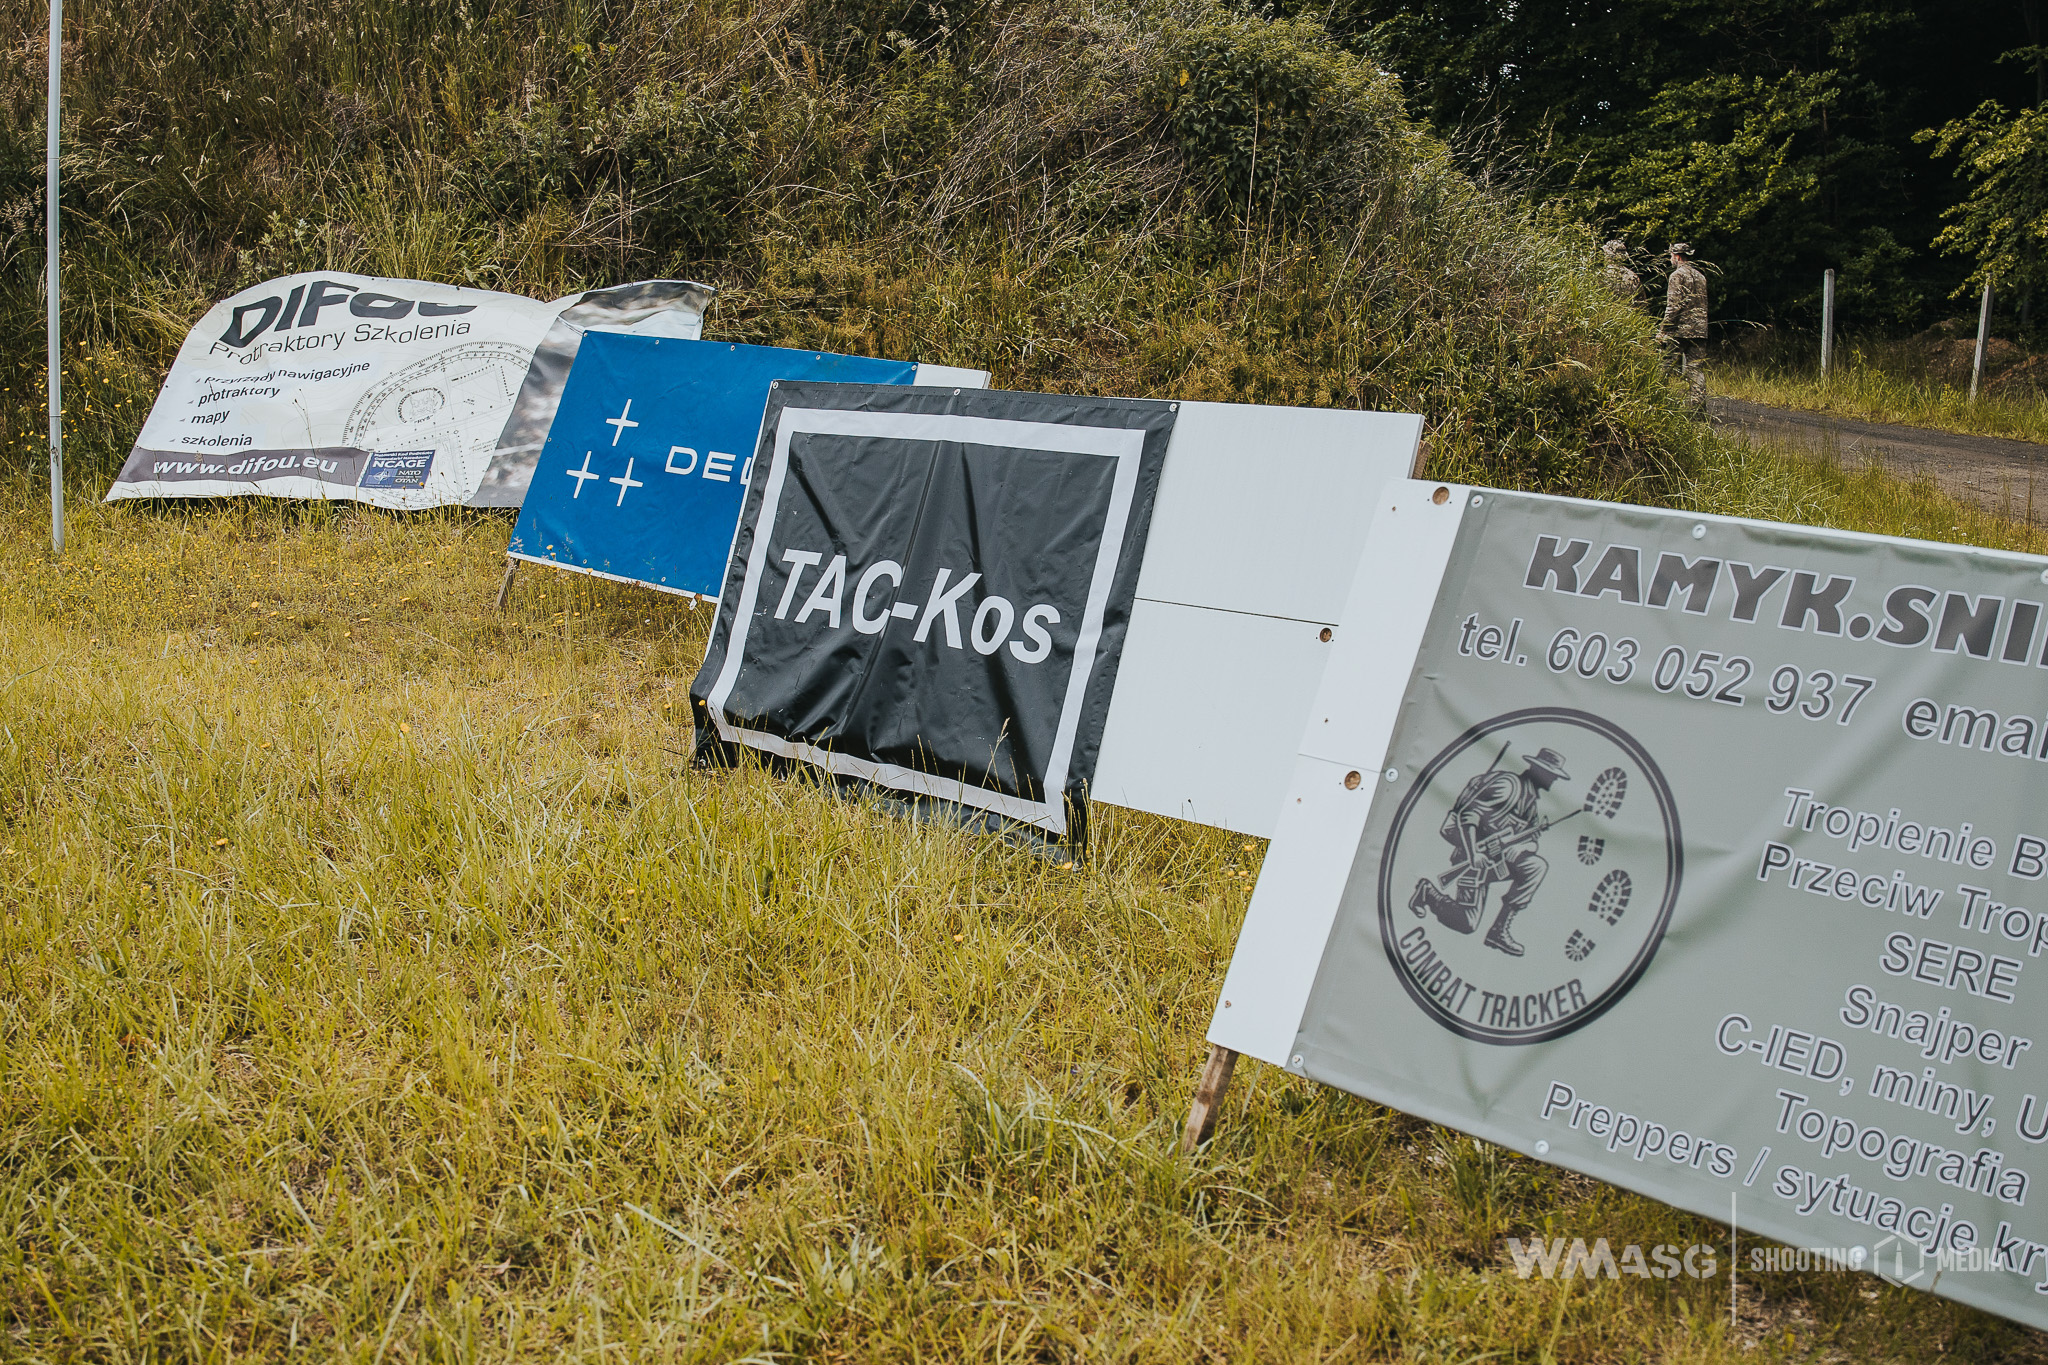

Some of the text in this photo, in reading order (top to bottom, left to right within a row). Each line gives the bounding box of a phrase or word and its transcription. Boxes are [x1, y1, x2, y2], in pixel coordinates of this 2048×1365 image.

[208, 319, 471, 366] Protraktory Szkolenia
[278, 362, 370, 383] nawigacyjne
[191, 410, 230, 425] mapy
[198, 386, 280, 407] protraktory
[153, 455, 339, 475] www.difou.eu
[181, 434, 253, 447] szkolenia
[372, 459, 427, 468] NCAGE
[1522, 532, 2048, 670] KAMYK.SNI
[1457, 612, 1527, 667] tel.
[1546, 627, 1640, 685] 603
[1652, 644, 1754, 706] 052
[1765, 663, 1876, 727] 937
[1782, 786, 1997, 869] Tropienie
[1756, 840, 1943, 920] Przeciw
[1400, 926, 1587, 1028] COMBAT TRACKER
[1879, 930, 2023, 1003] SERE
[1839, 983, 2032, 1070] Snajper
[1714, 1012, 1854, 1095] C-IED,
[1868, 1065, 1996, 1137] miny,
[1540, 1080, 1737, 1178] Preppers
[1742, 1146, 1772, 1187] /
[1773, 1165, 1980, 1258] sytuacje
[1773, 1089, 2030, 1206] Topografia
